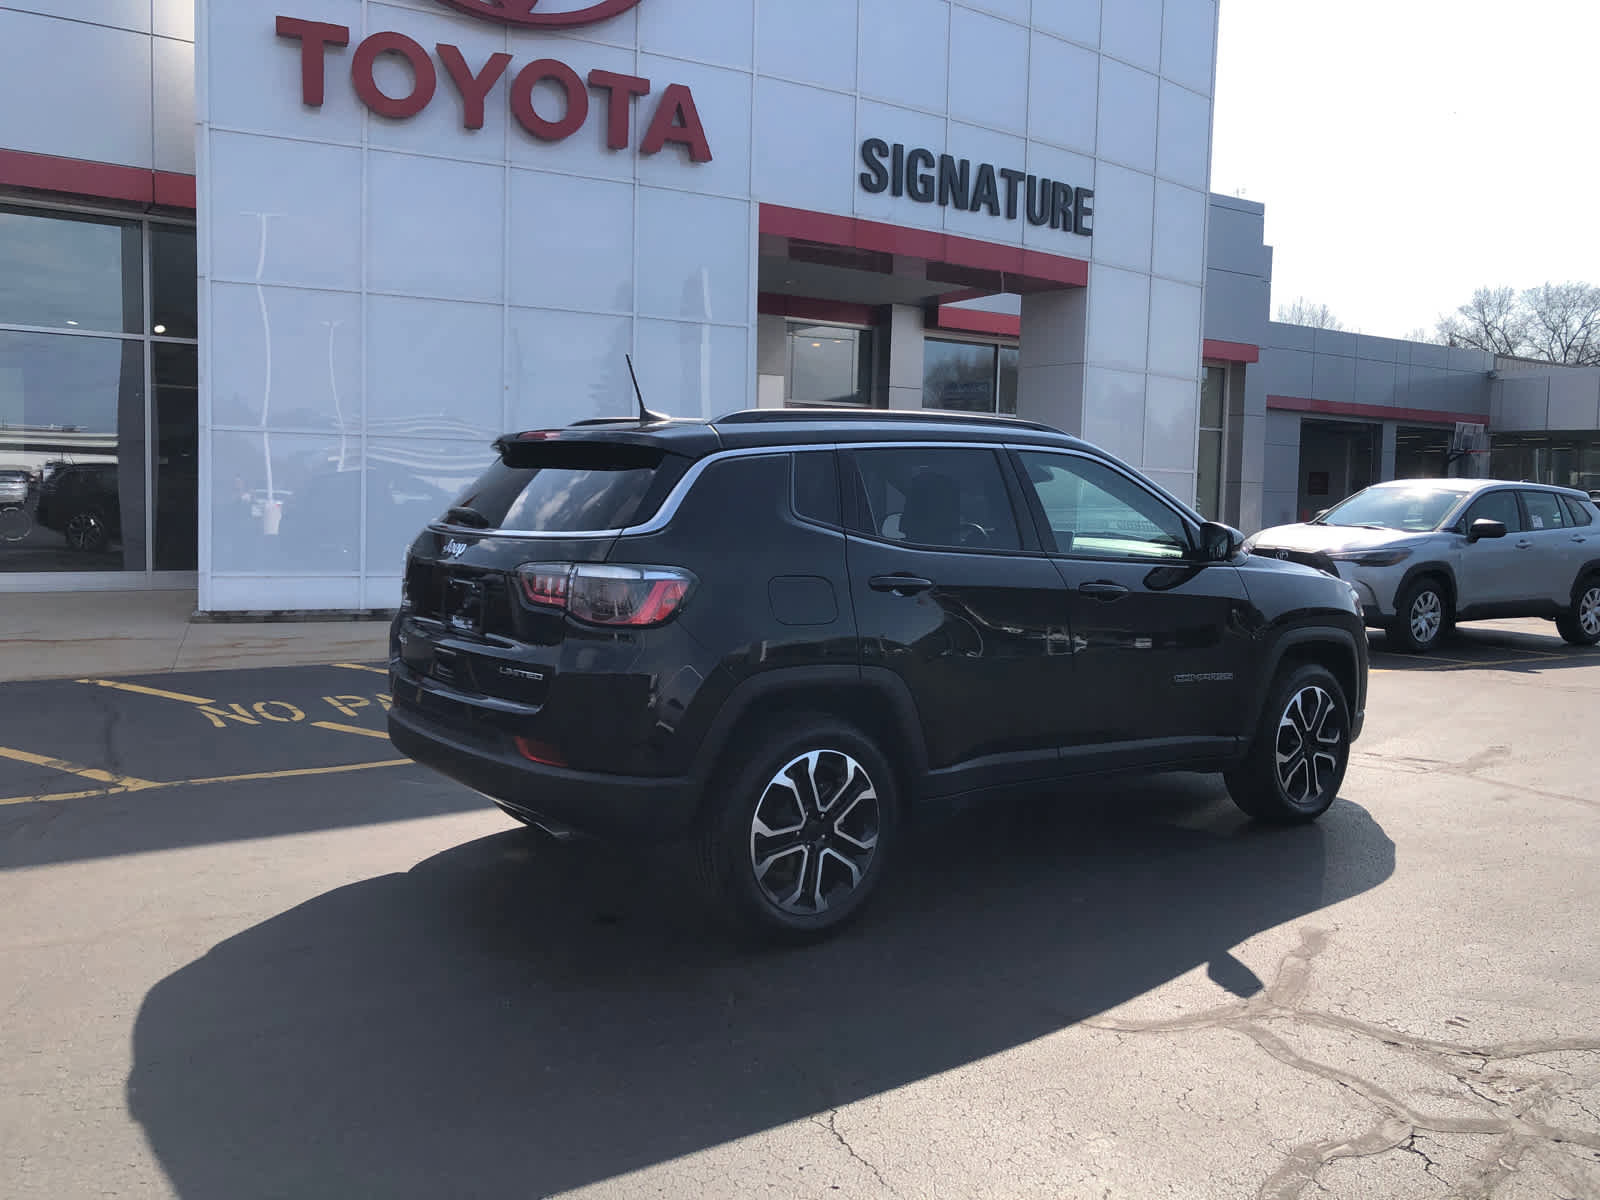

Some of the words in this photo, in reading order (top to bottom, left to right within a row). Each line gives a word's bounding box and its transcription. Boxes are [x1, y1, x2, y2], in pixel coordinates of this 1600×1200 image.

[276, 15, 712, 163] TOYOTA
[860, 138, 1095, 236] SIGNATURE
[442, 538, 467, 557] Jeep
[195, 700, 306, 728] NO
